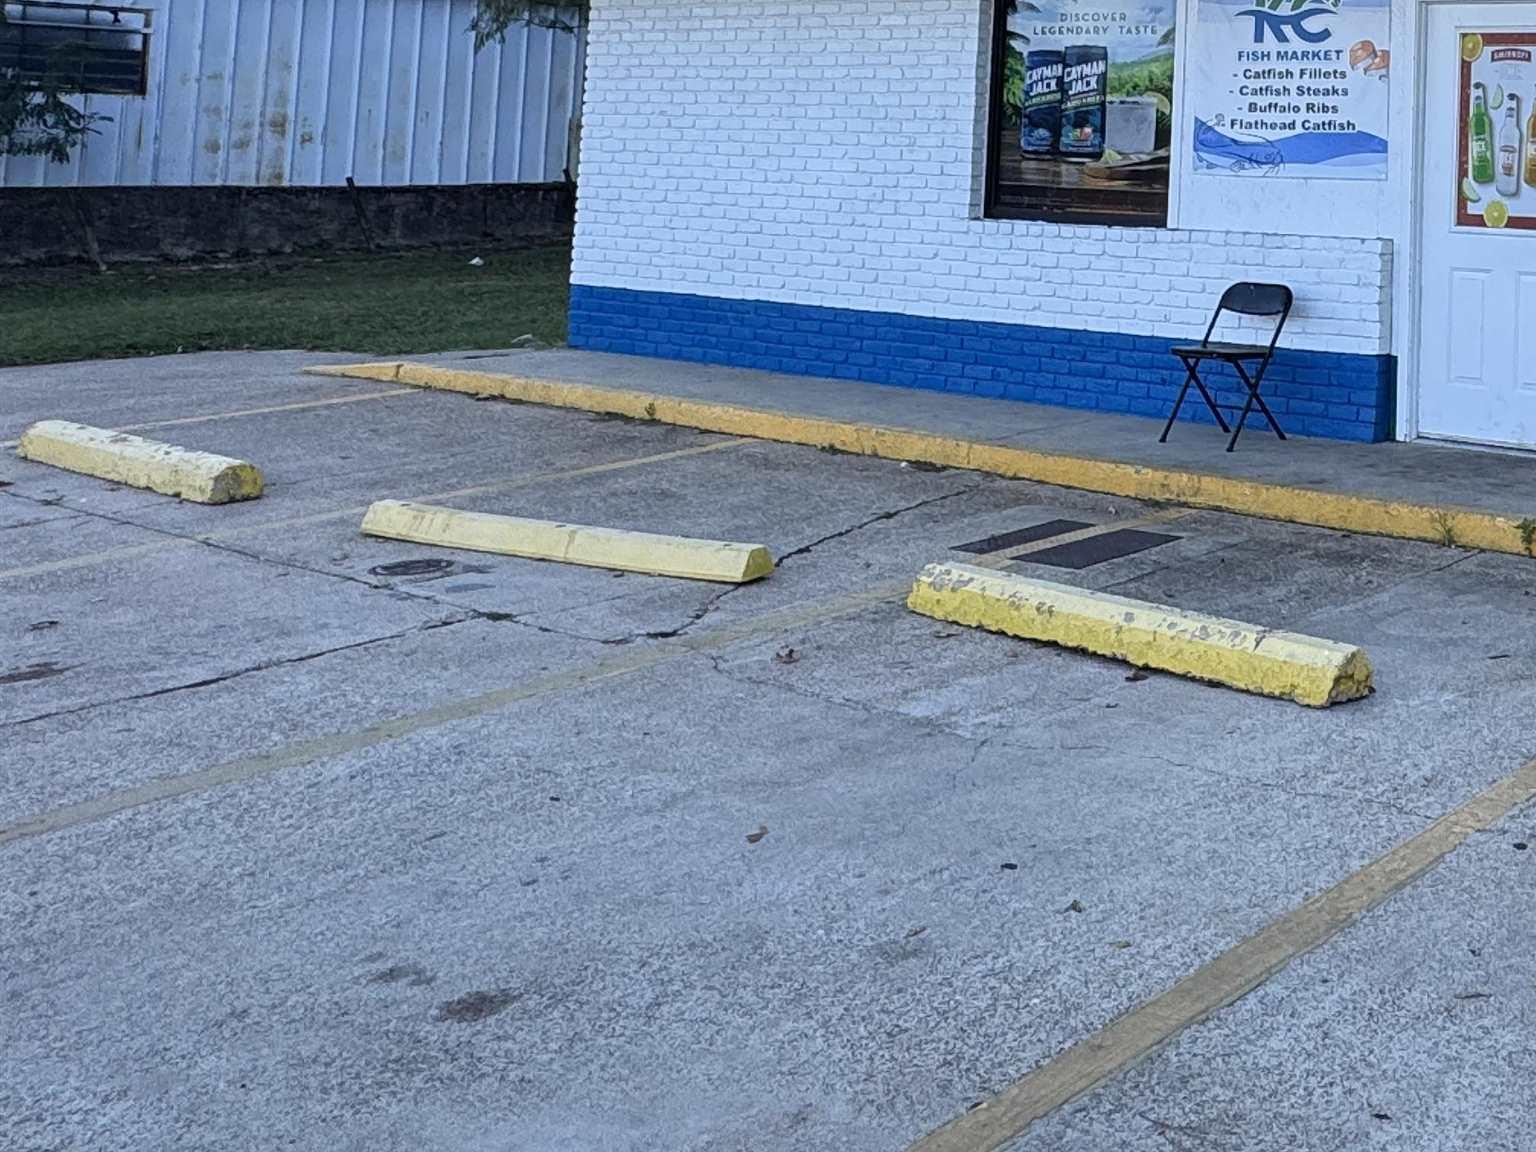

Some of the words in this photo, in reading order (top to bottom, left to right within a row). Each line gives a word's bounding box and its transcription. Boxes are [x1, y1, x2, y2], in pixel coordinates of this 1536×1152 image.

[1060, 12, 1127, 22] DISCOVER
[1033, 25, 1110, 35] LEGENDARY
[1119, 25, 1158, 35] TASTE
[1237, 50, 1271, 61] FISH
[1276, 49, 1343, 61] MARKET
[1064, 60, 1106, 82] CAYMAN
[1243, 68, 1294, 80] Catfish
[1299, 68, 1347, 80] Fillets
[1029, 79, 1057, 97] JACK
[1068, 76, 1098, 95] JACK
[1239, 85, 1291, 97] Catfish
[1295, 85, 1349, 97] Steaks
[1248, 102, 1301, 114] Buffalo
[1306, 102, 1339, 114] Ribs
[1230, 118, 1297, 130] Flathead
[1301, 119, 1356, 131] Catfish
